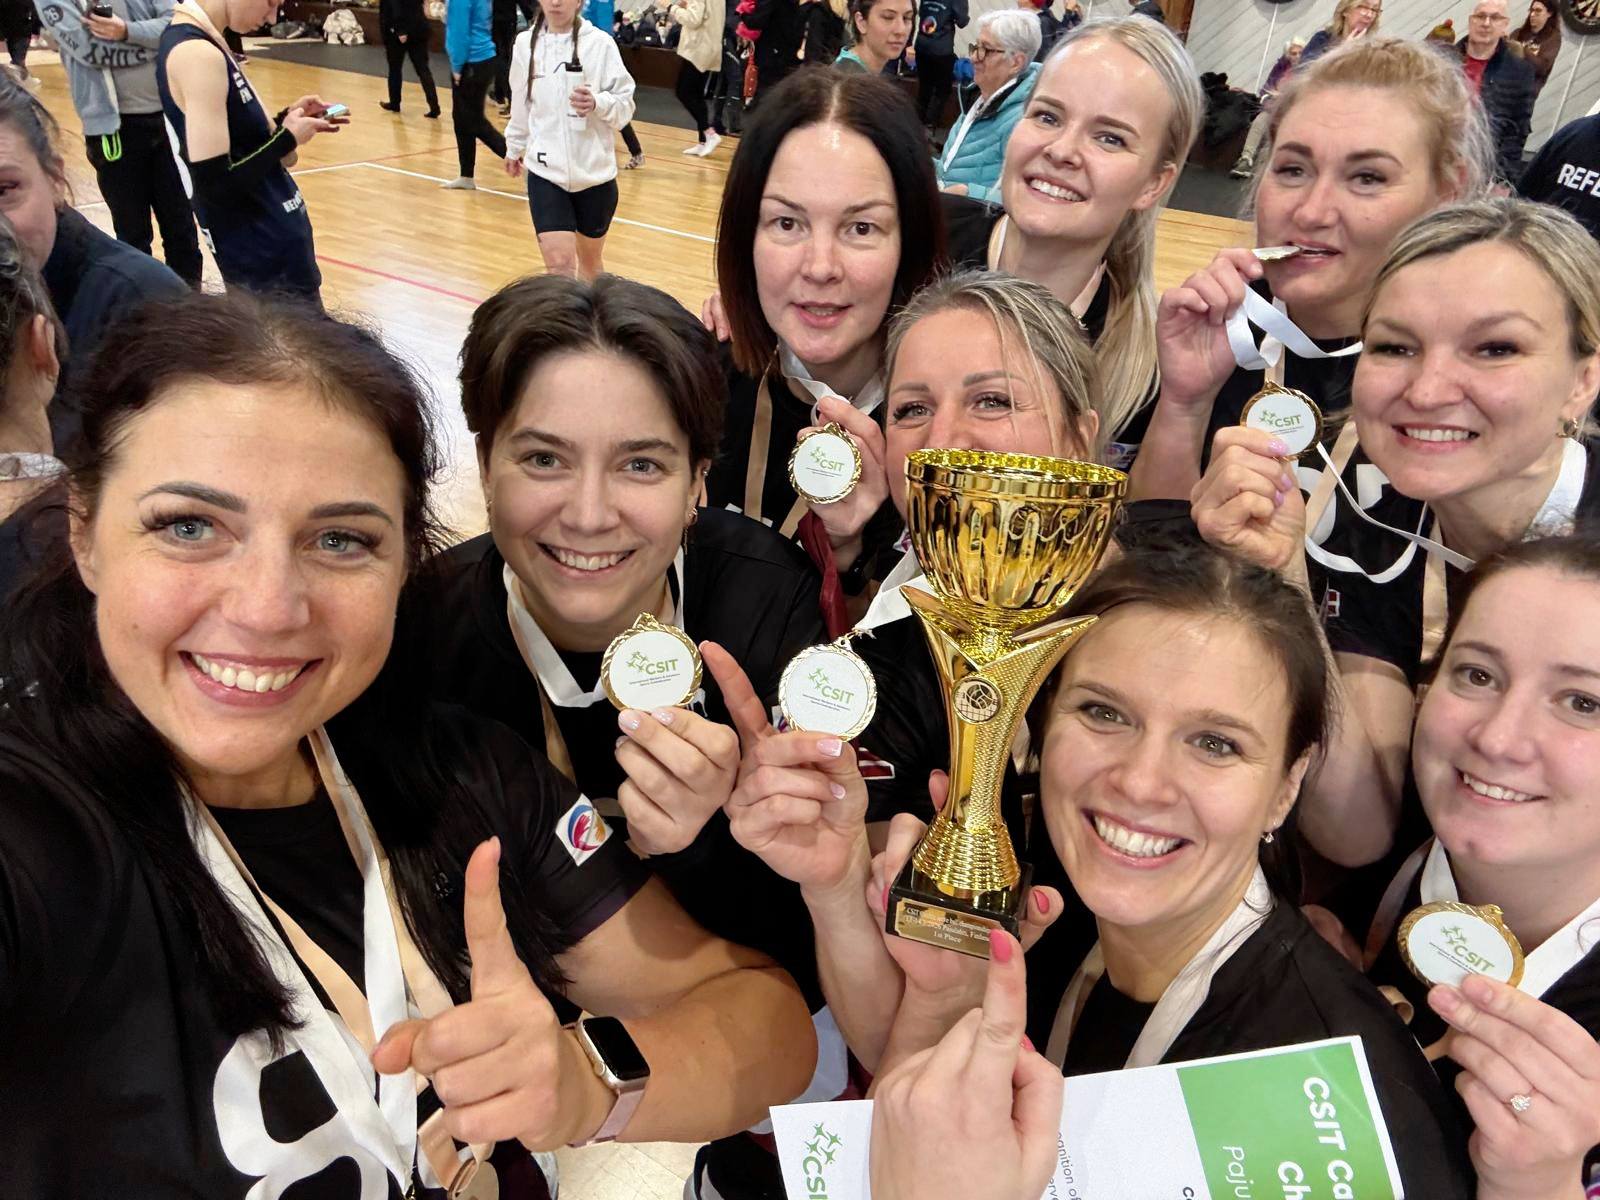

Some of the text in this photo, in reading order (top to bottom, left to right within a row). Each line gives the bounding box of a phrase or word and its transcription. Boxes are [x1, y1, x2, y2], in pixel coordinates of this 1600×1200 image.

[1275, 414, 1302, 428] CSIT
[820, 459, 845, 472] CSIT
[645, 658, 679, 675] CSIT
[821, 685, 855, 704] CSIT
[1454, 945, 1495, 972] CSIT
[1303, 1077, 1347, 1150] CSIT
[1222, 1146, 1254, 1198] Paju
[1277, 1161, 1312, 1200] Ch
